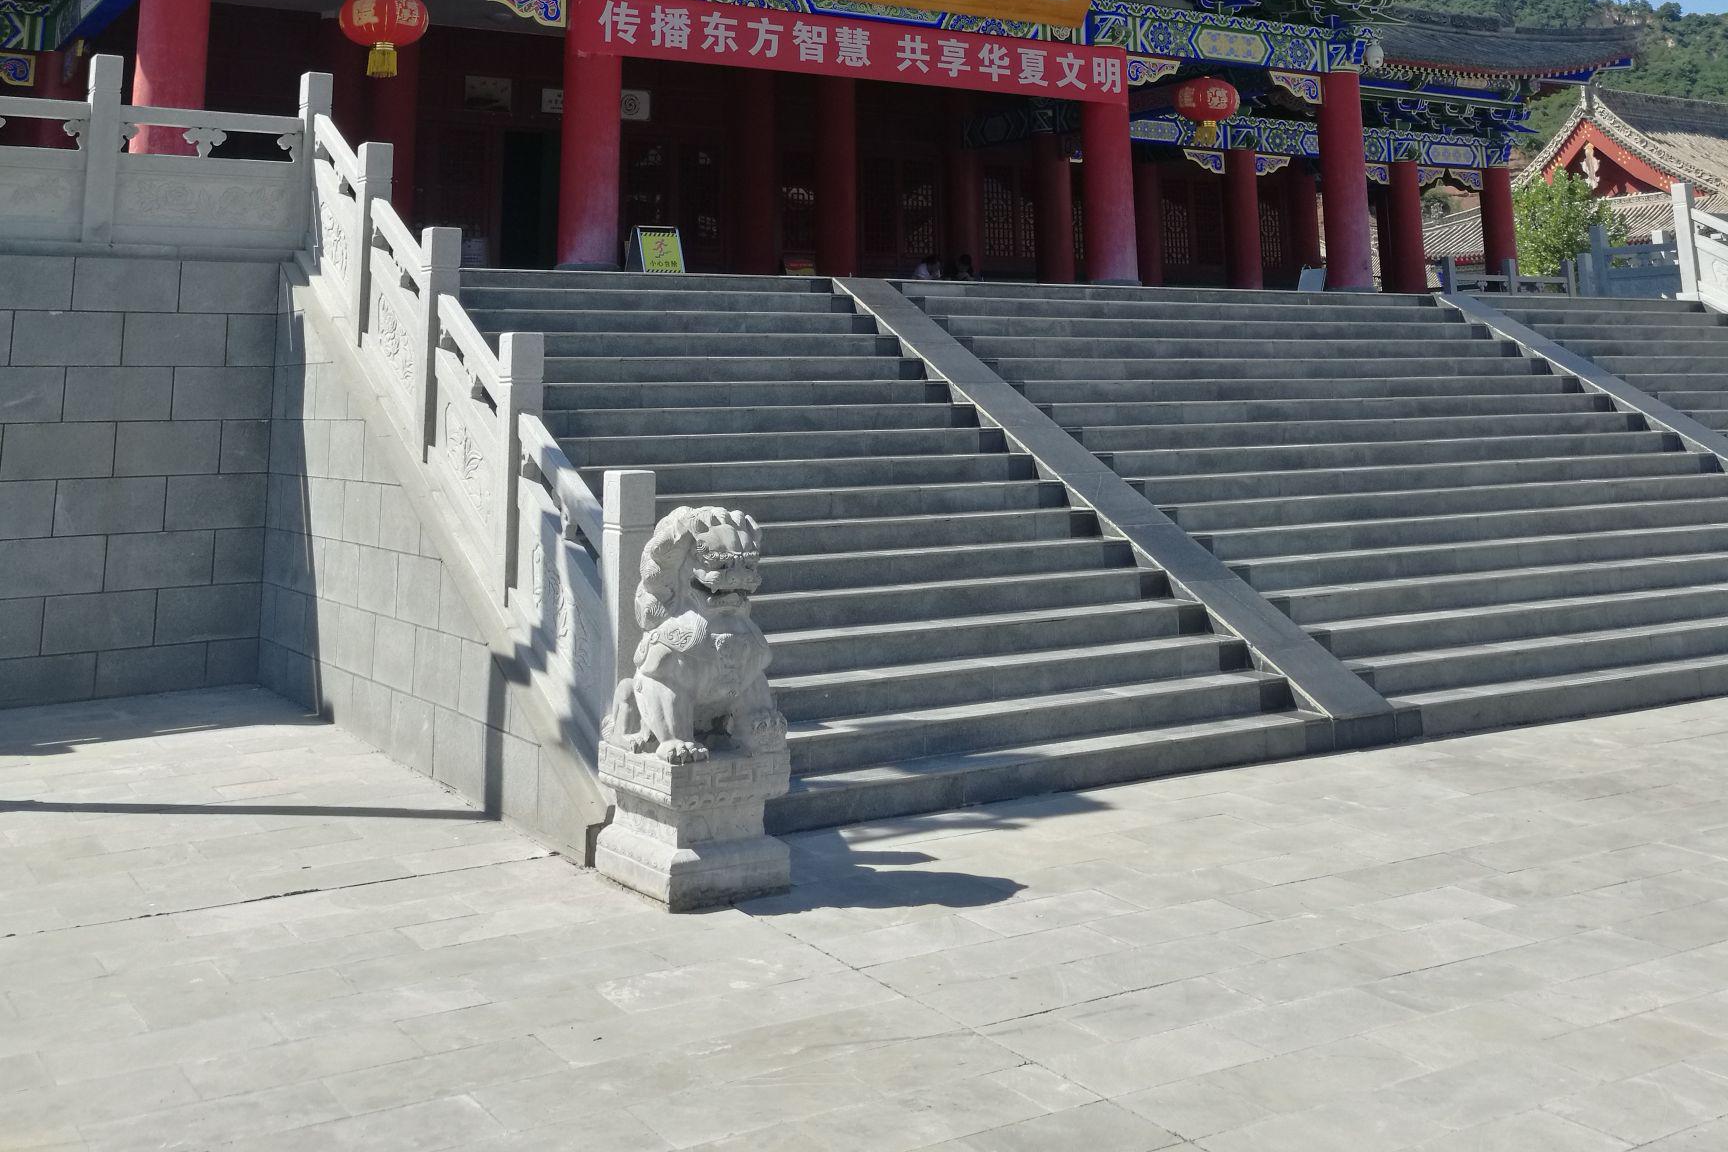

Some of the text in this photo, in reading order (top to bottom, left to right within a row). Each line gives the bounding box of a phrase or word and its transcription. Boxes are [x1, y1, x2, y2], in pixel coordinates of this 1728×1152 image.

[598, 0, 1122, 94] 传播东方智慧 共享华夏文明
